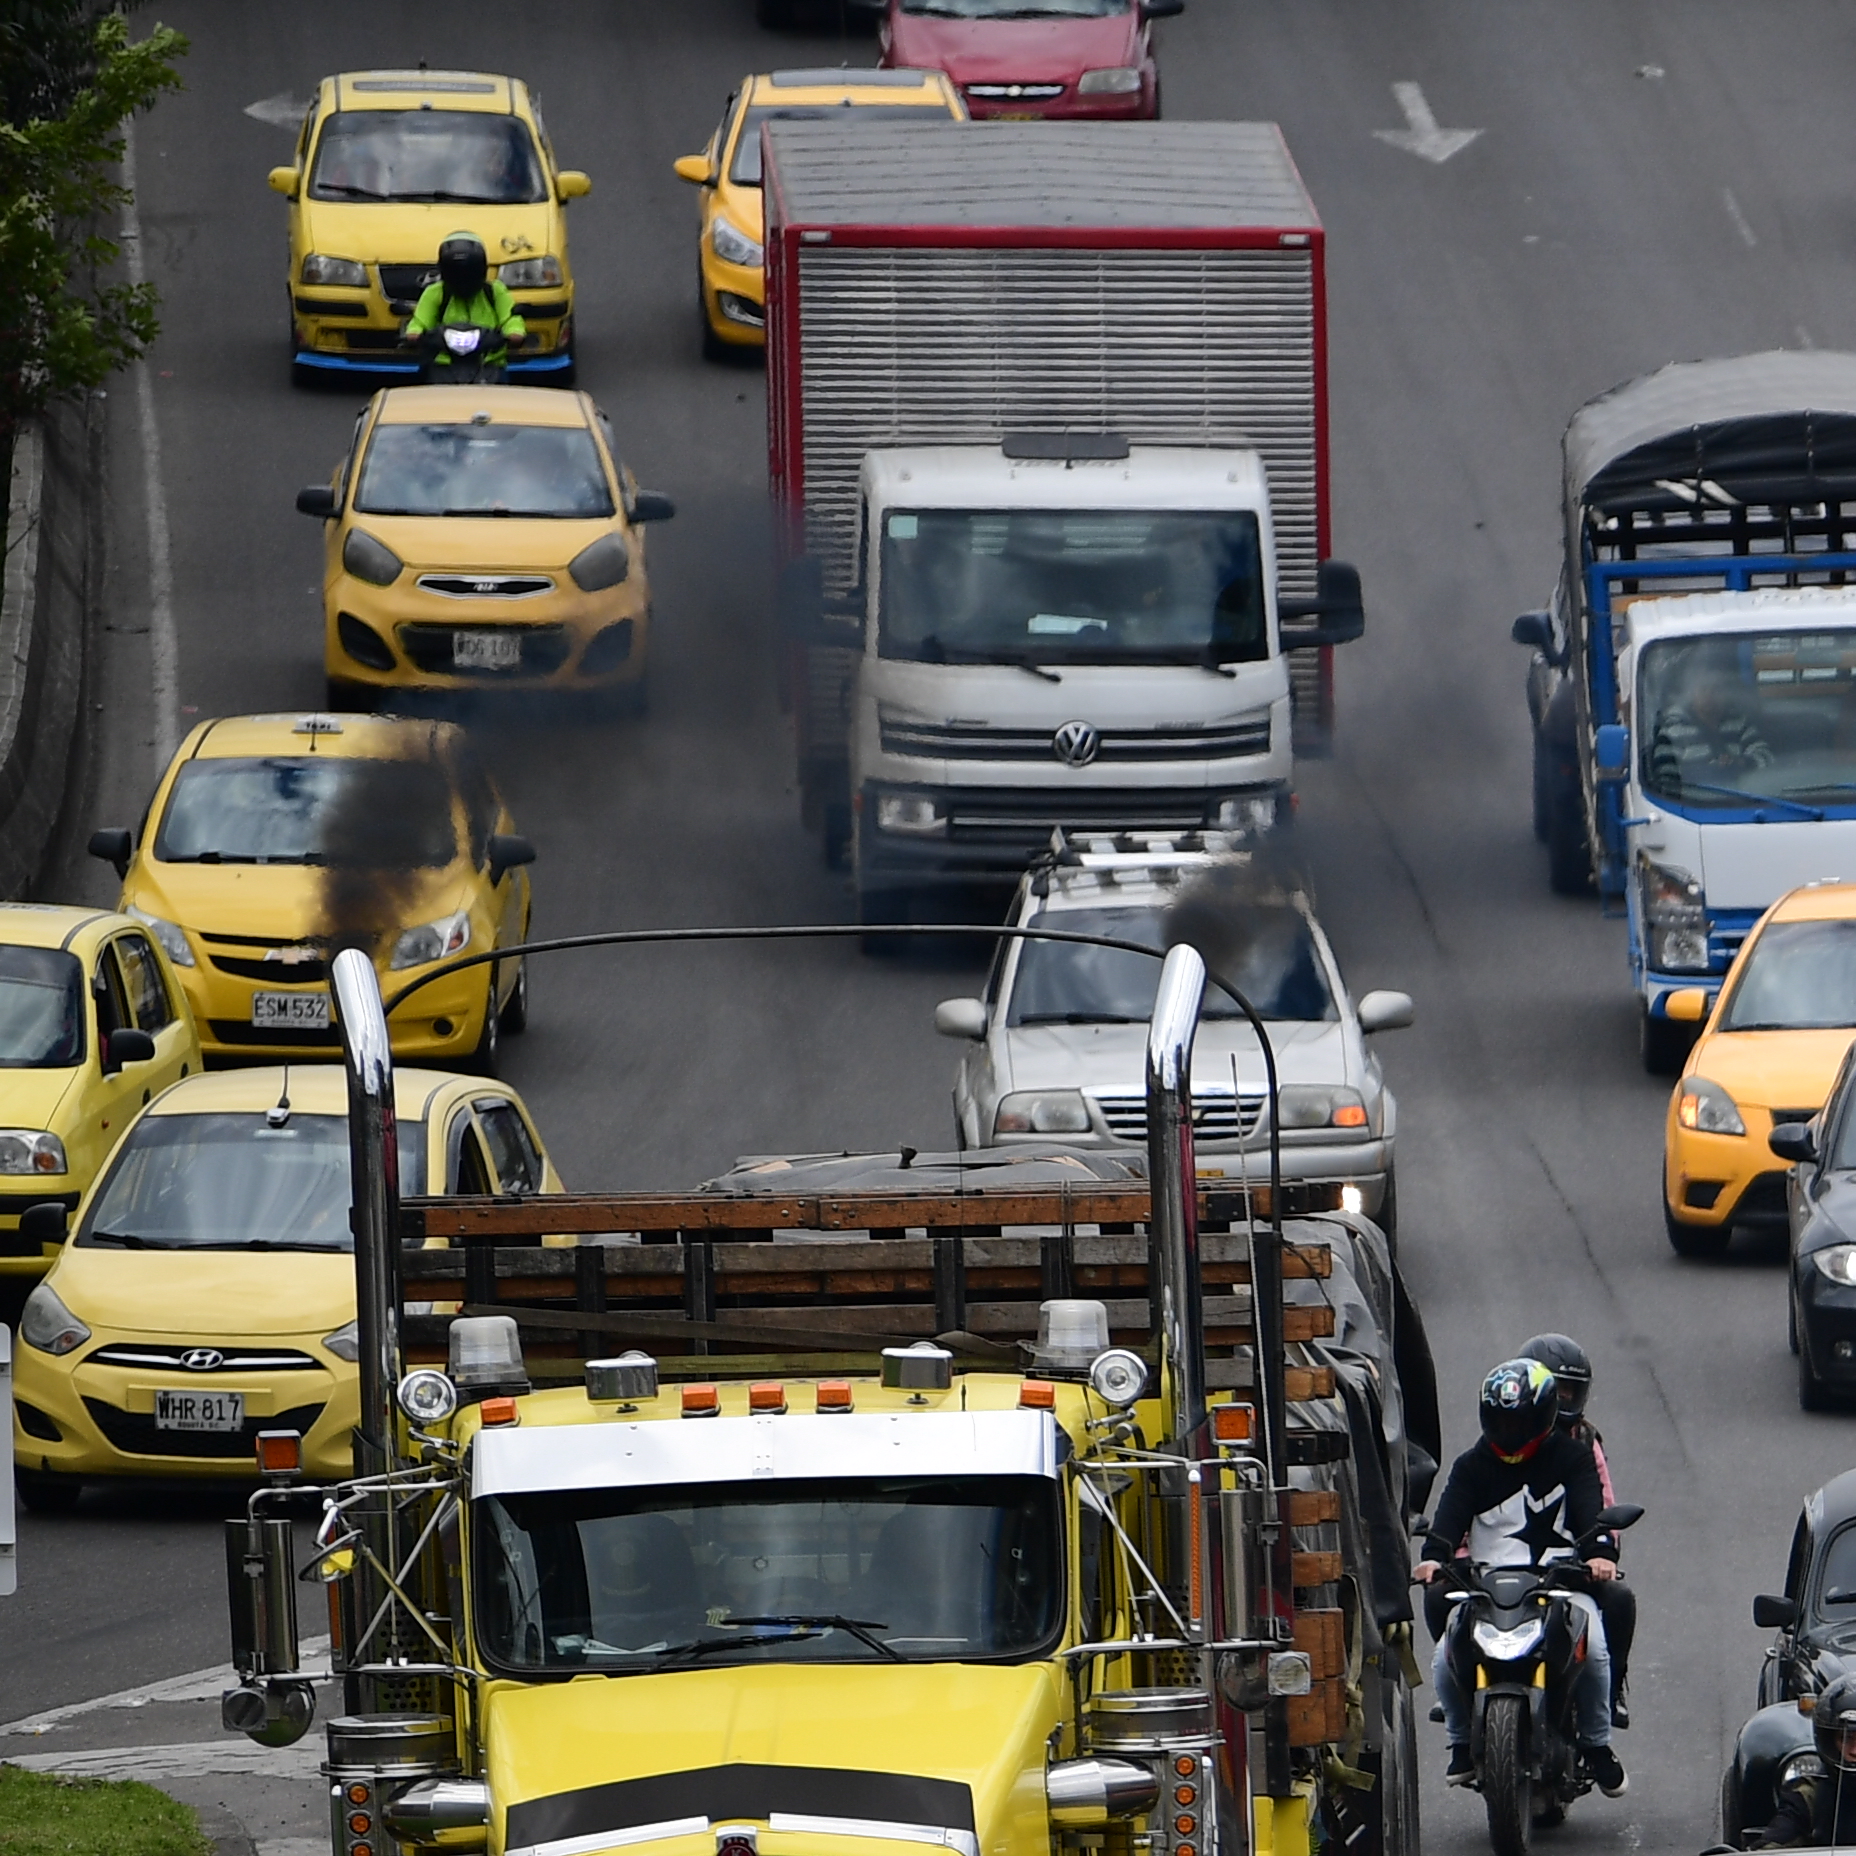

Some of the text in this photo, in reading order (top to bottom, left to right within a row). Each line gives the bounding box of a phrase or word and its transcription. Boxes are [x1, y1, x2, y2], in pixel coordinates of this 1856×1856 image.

[254, 997, 327, 1020] ESM 532
[158, 1397, 240, 1422] WHR 817
